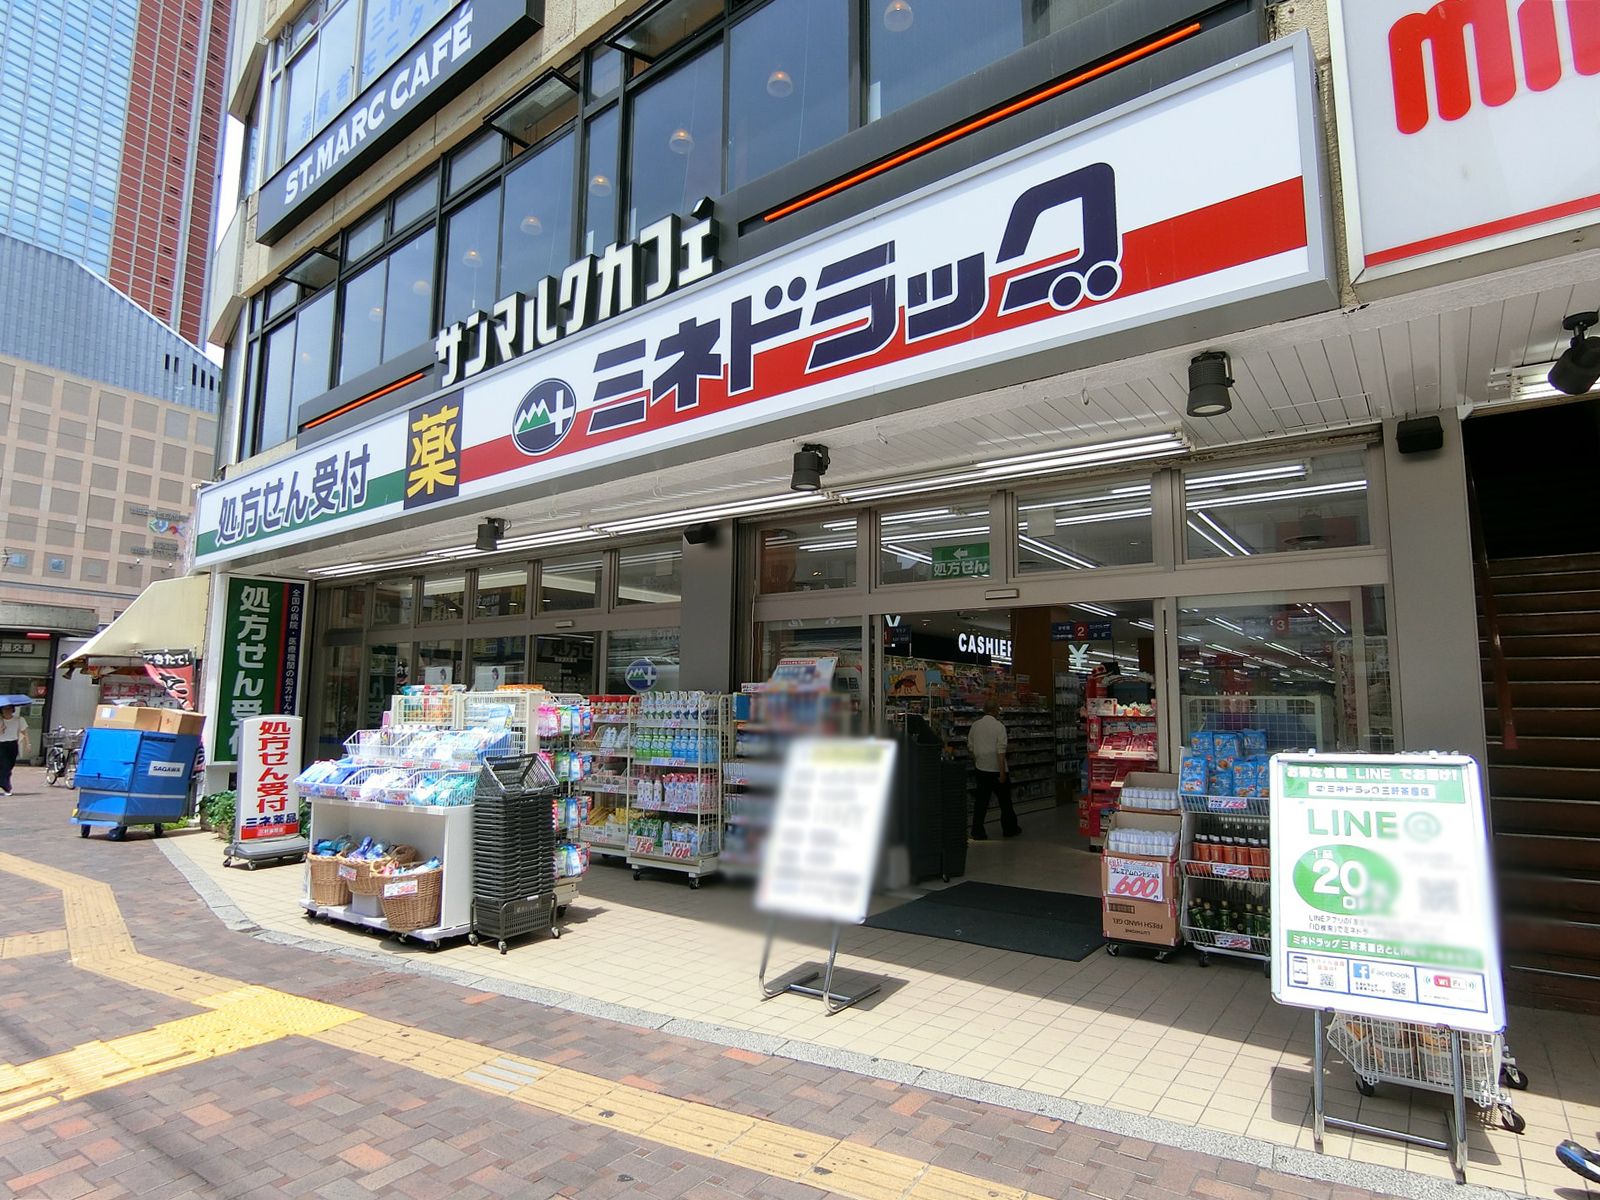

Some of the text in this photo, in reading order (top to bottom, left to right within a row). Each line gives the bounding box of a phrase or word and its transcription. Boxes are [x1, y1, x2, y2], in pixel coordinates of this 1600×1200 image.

[284, 7, 474, 206] ST.MARC CAFÉ
[435, 197, 720, 388] サンマルクカフェ
[587, 161, 1124, 436] ミネドラッグ
[216, 444, 370, 547] 処方せん受付
[407, 405, 460, 498] 薬
[933, 560, 988, 577] 処方せん
[152, 765, 181, 774] SAGAWA
[256, 721, 291, 813] 処方せん受付
[1355, 768, 1392, 780] LINE
[245, 812, 298, 828] ミネ薬品
[1115, 875, 1159, 898] 600
